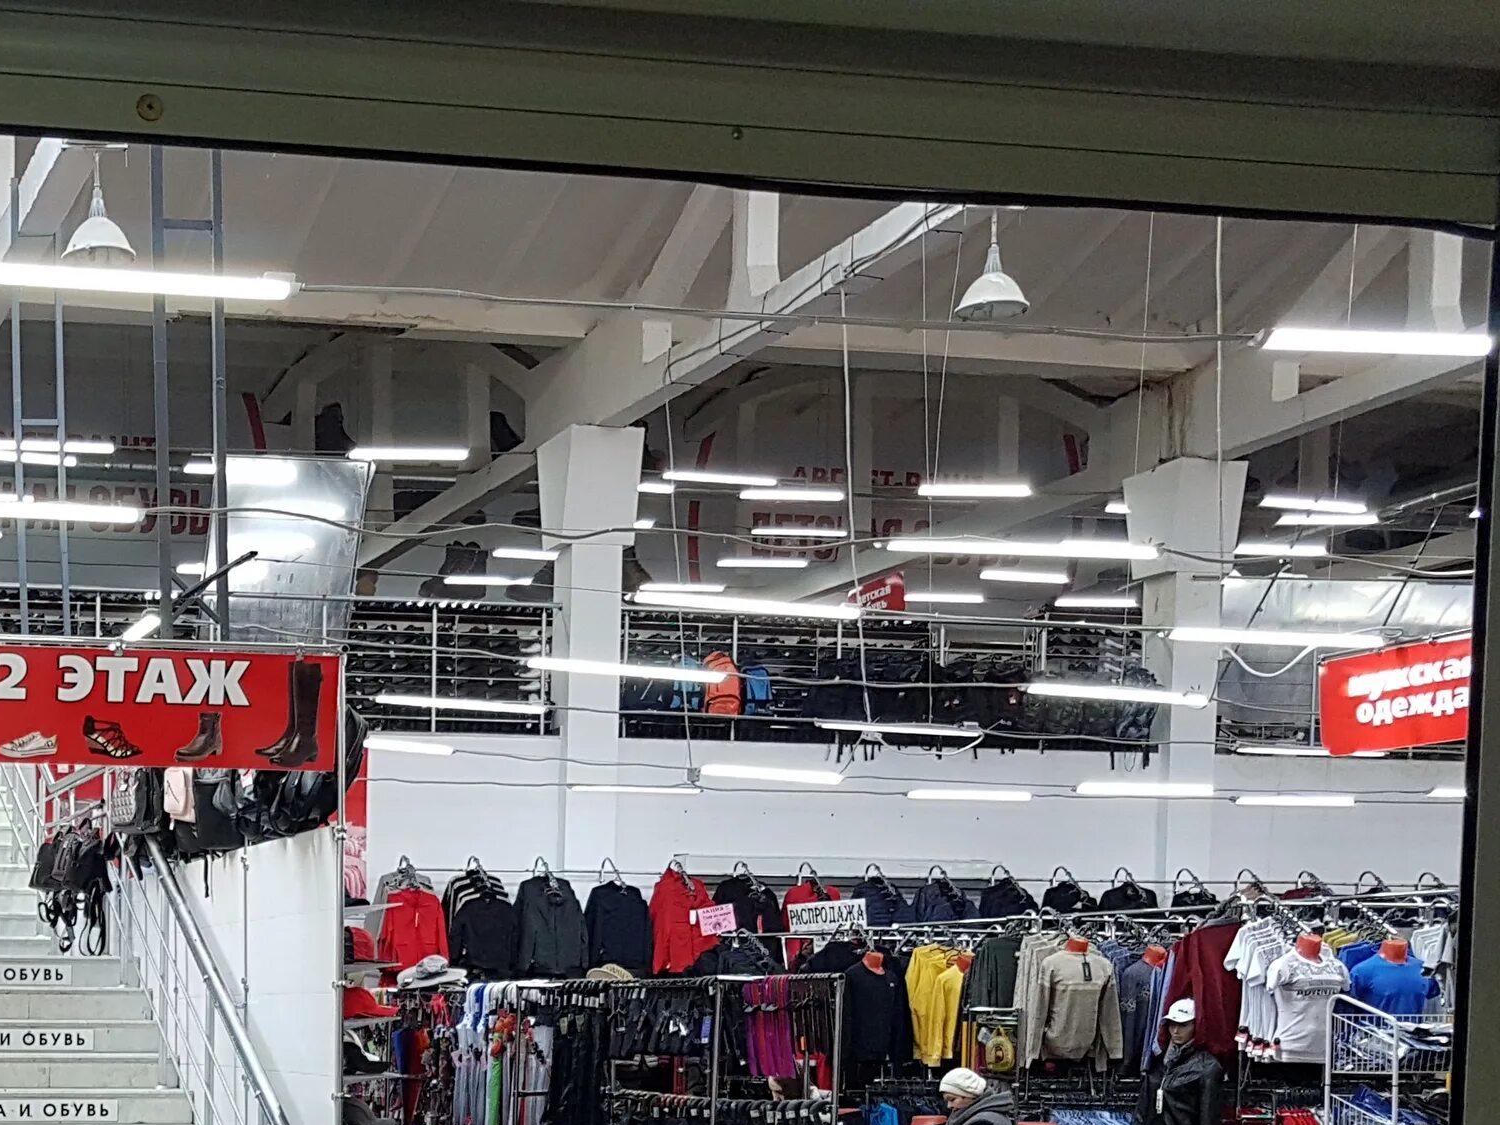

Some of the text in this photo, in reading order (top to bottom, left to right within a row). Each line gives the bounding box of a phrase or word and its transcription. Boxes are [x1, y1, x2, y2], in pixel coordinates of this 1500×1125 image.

[56, 654, 252, 707] ЭТАЖ
[1356, 686, 1470, 726] одежда
[790, 904, 866, 926] РАСПРОДАЖА
[4, 967, 63, 981] ОБУВЬ
[0, 1032, 10, 1045] И
[23, 1031, 85, 1046] ОБУВЬ
[20, 1103, 30, 1118] И
[43, 1102, 109, 1117] ОБУВЬ
